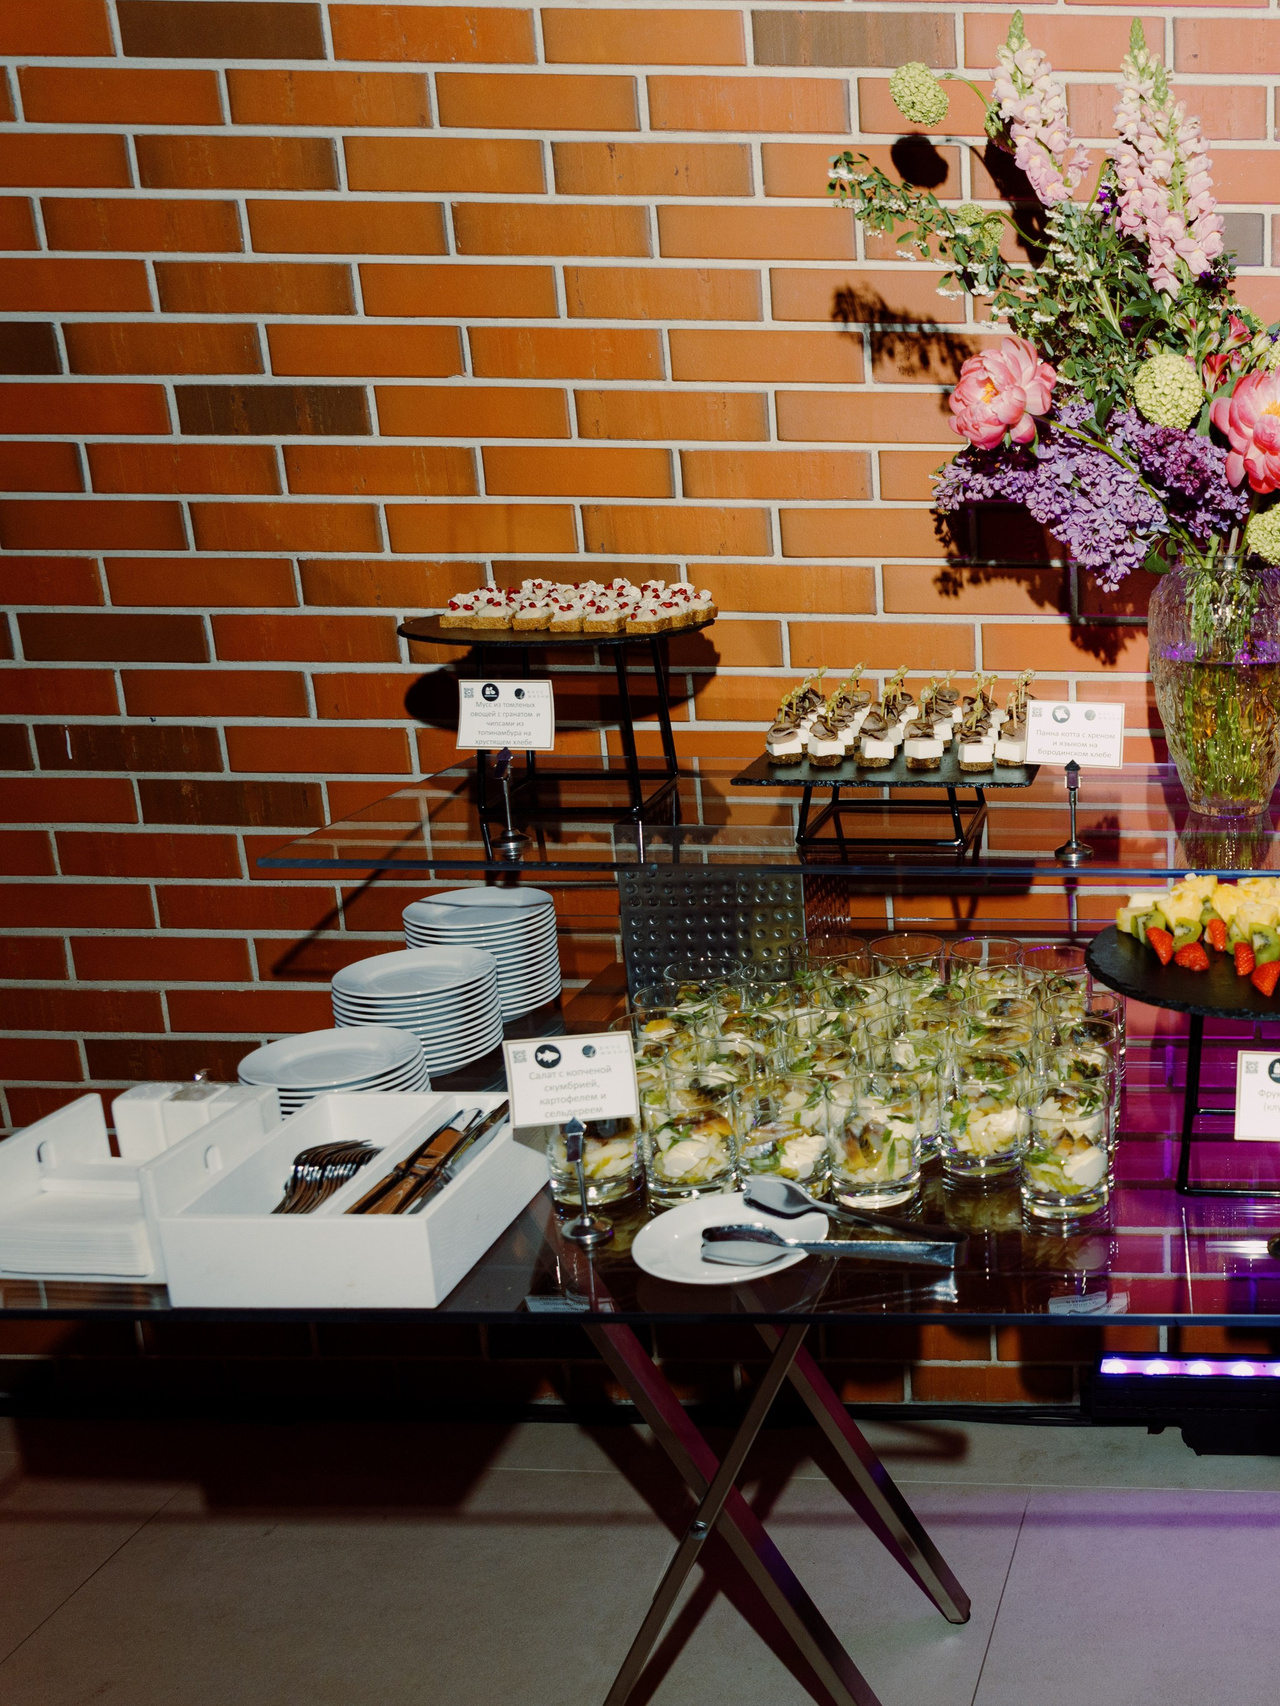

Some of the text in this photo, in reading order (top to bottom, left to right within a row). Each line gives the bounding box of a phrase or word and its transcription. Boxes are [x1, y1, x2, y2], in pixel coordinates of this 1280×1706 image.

[478, 729, 522, 737] топинамбура
[1036, 729, 1059, 737] Панна
[1037, 748, 1089, 757] бородинском
[529, 1071, 556, 1080] Салат
[566, 1065, 612, 1077] копченой
[544, 1079, 600, 1092] скумбрией,
[539, 1094, 598, 1105] картофелем
[545, 1106, 604, 1118] сельдереем
